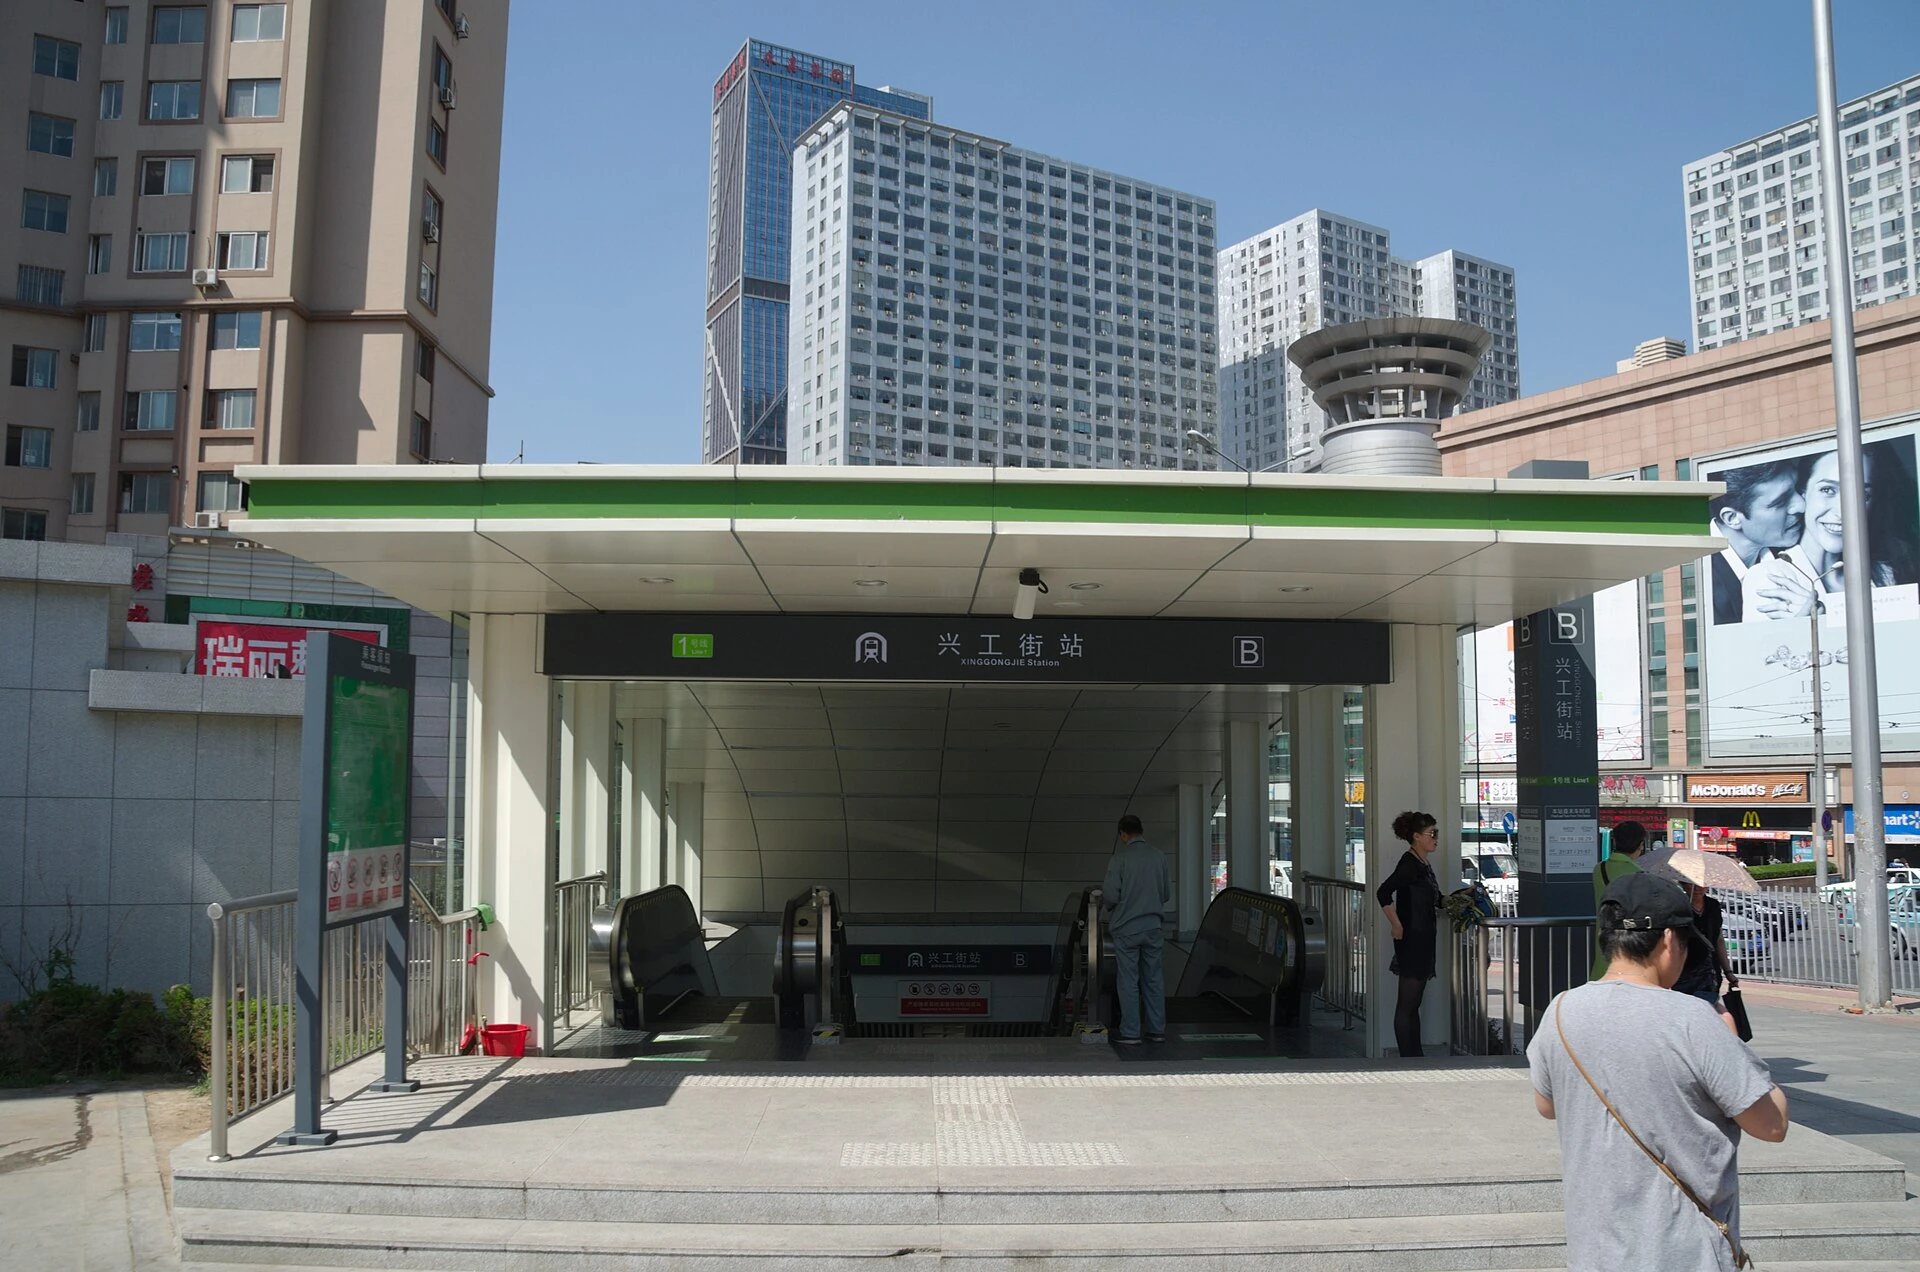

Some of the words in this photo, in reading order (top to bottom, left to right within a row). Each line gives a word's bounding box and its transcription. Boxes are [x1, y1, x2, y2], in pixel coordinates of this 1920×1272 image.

[1521, 616, 1530, 642] B
[1558, 613, 1578, 639] B
[938, 632, 1083, 657] 兴工街站
[1240, 640, 1259, 664] B
[960, 658, 1025, 667] XINGGONGJIE
[1027, 658, 1060, 667] Station
[1555, 657, 1573, 740] 兴工街站
[1691, 784, 1766, 797] McDonald's
[928, 952, 981, 964] 兴工街站
[1015, 954, 1025, 966] B
